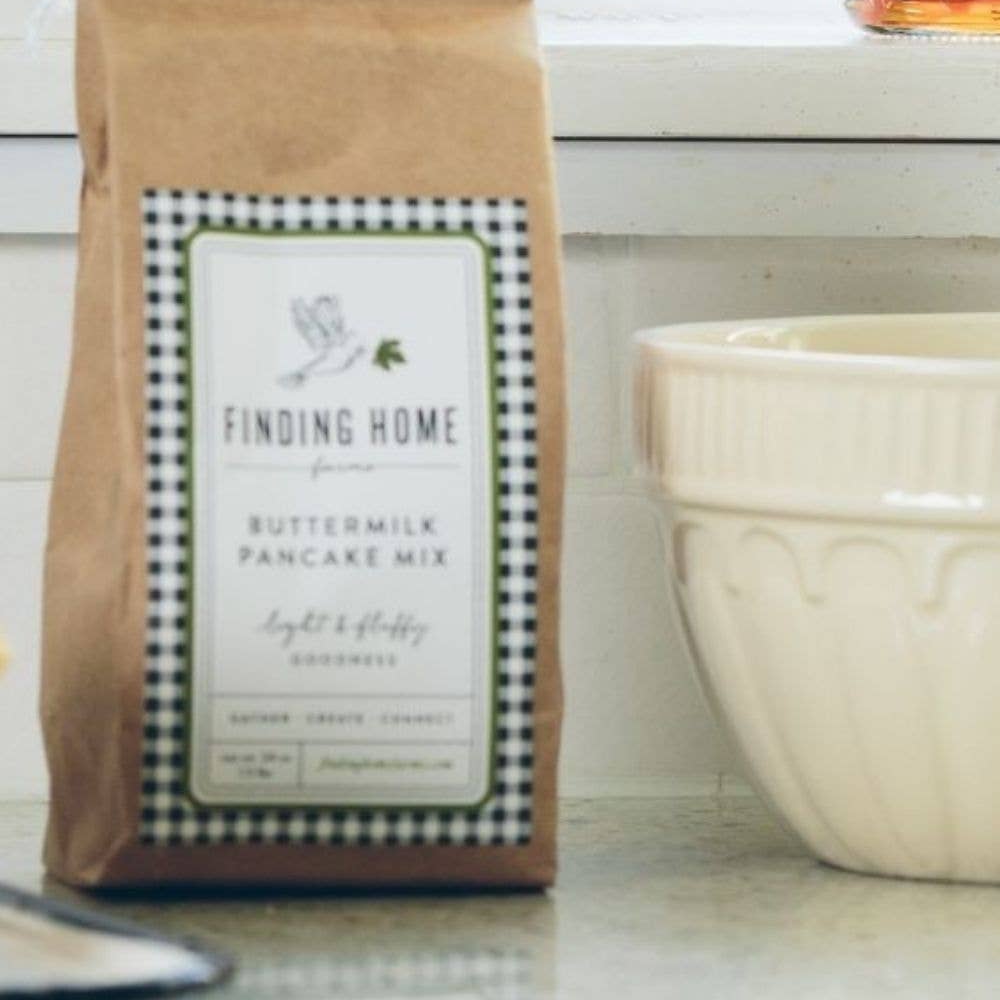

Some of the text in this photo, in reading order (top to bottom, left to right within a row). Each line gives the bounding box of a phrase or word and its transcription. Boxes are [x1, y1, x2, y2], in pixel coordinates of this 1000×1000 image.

[223, 405, 459, 447] FINDING HOME
[248, 515, 436, 537] BUTTERMILK
[237, 546, 449, 569] PANCAKE MIX
